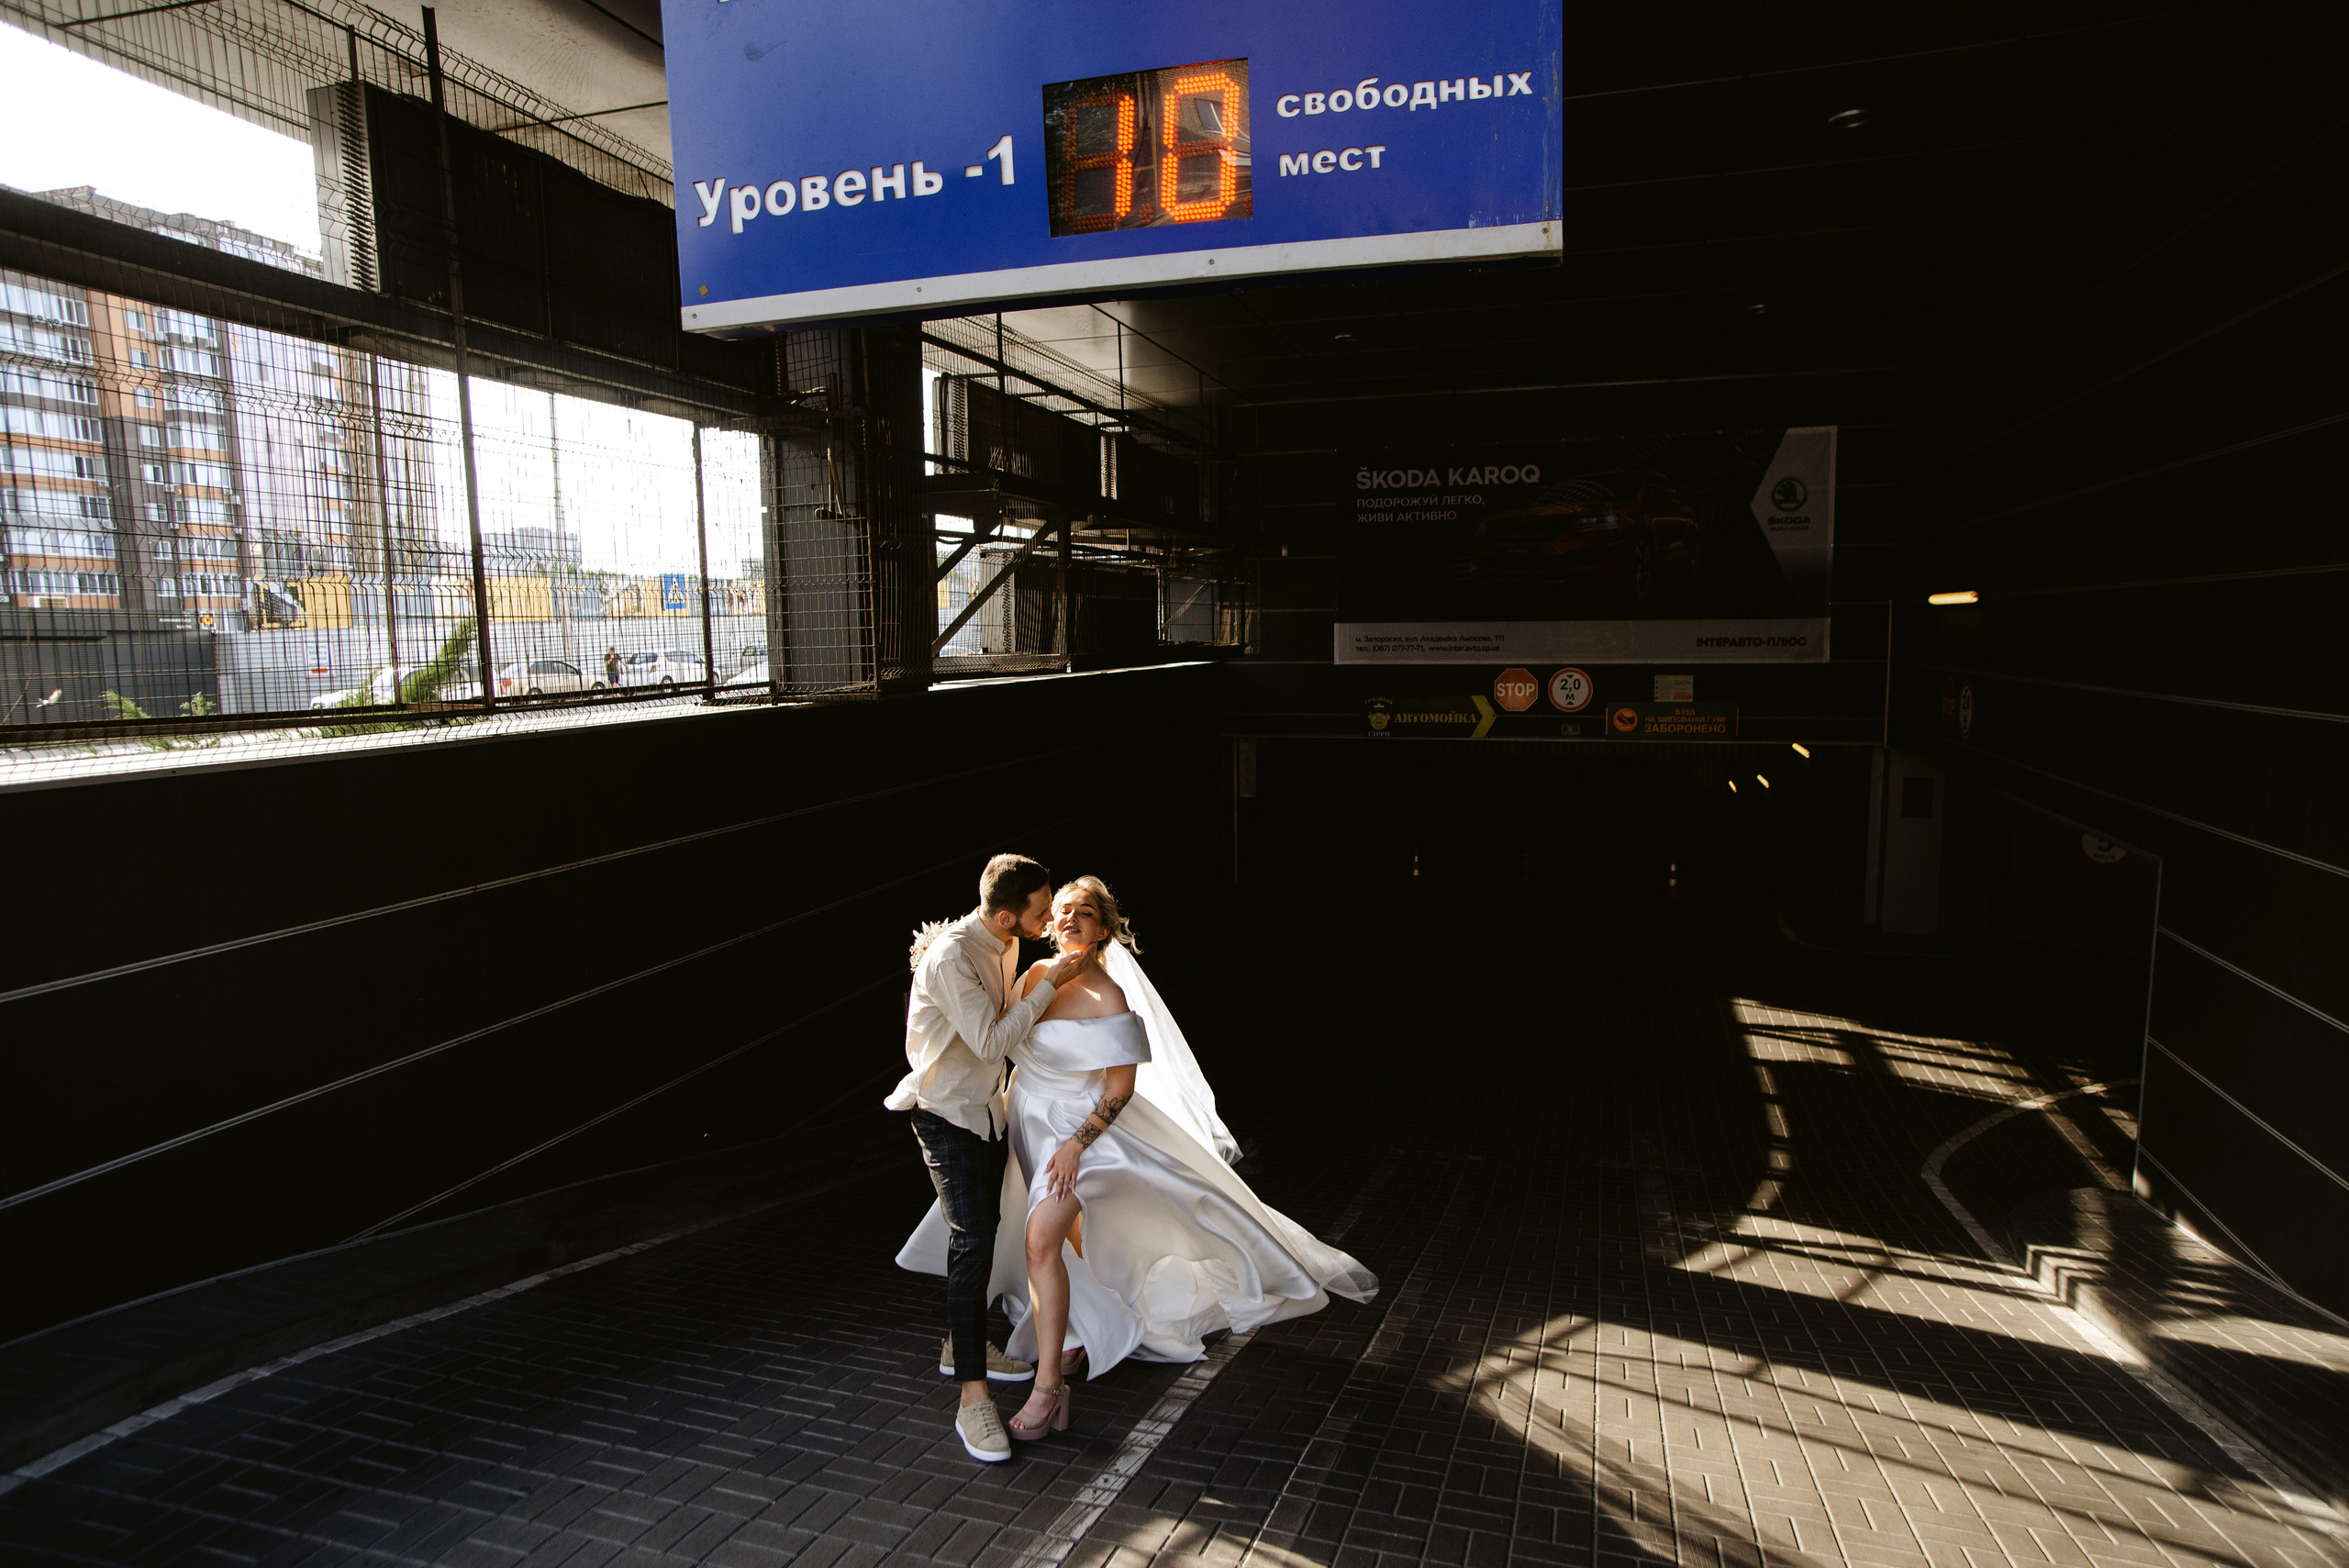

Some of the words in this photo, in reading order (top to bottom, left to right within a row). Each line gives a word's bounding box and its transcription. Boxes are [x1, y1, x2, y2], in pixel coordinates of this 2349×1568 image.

[1276, 71, 1532, 117] свободных
[1114, 72, 1241, 221] 10
[1279, 144, 1386, 177] мест
[693, 161, 943, 234] Уровень
[964, 135, 1015, 186] -1
[1356, 466, 1442, 490] ŠKODA
[1448, 464, 1541, 486] KAROQ
[1356, 494, 1438, 509] ПОДОРОЖУЙ
[1441, 495, 1485, 506] ЛЕГКО,
[1357, 512, 1394, 523] ЖИВИ
[1397, 510, 1457, 522] АКТИВНО
[1364, 635, 1404, 644] Запоріжжя,
[1696, 637, 1808, 647] ІНТЕРАВТО-ПЛЮС
[1372, 644, 1390, 652] (067)
[1497, 683, 1535, 697] STOP
[1560, 678, 1581, 692] 2,0
[1394, 710, 1477, 723] АВТОМОЙКА
[1644, 723, 1726, 733] ЗАБОРОНЕНО
